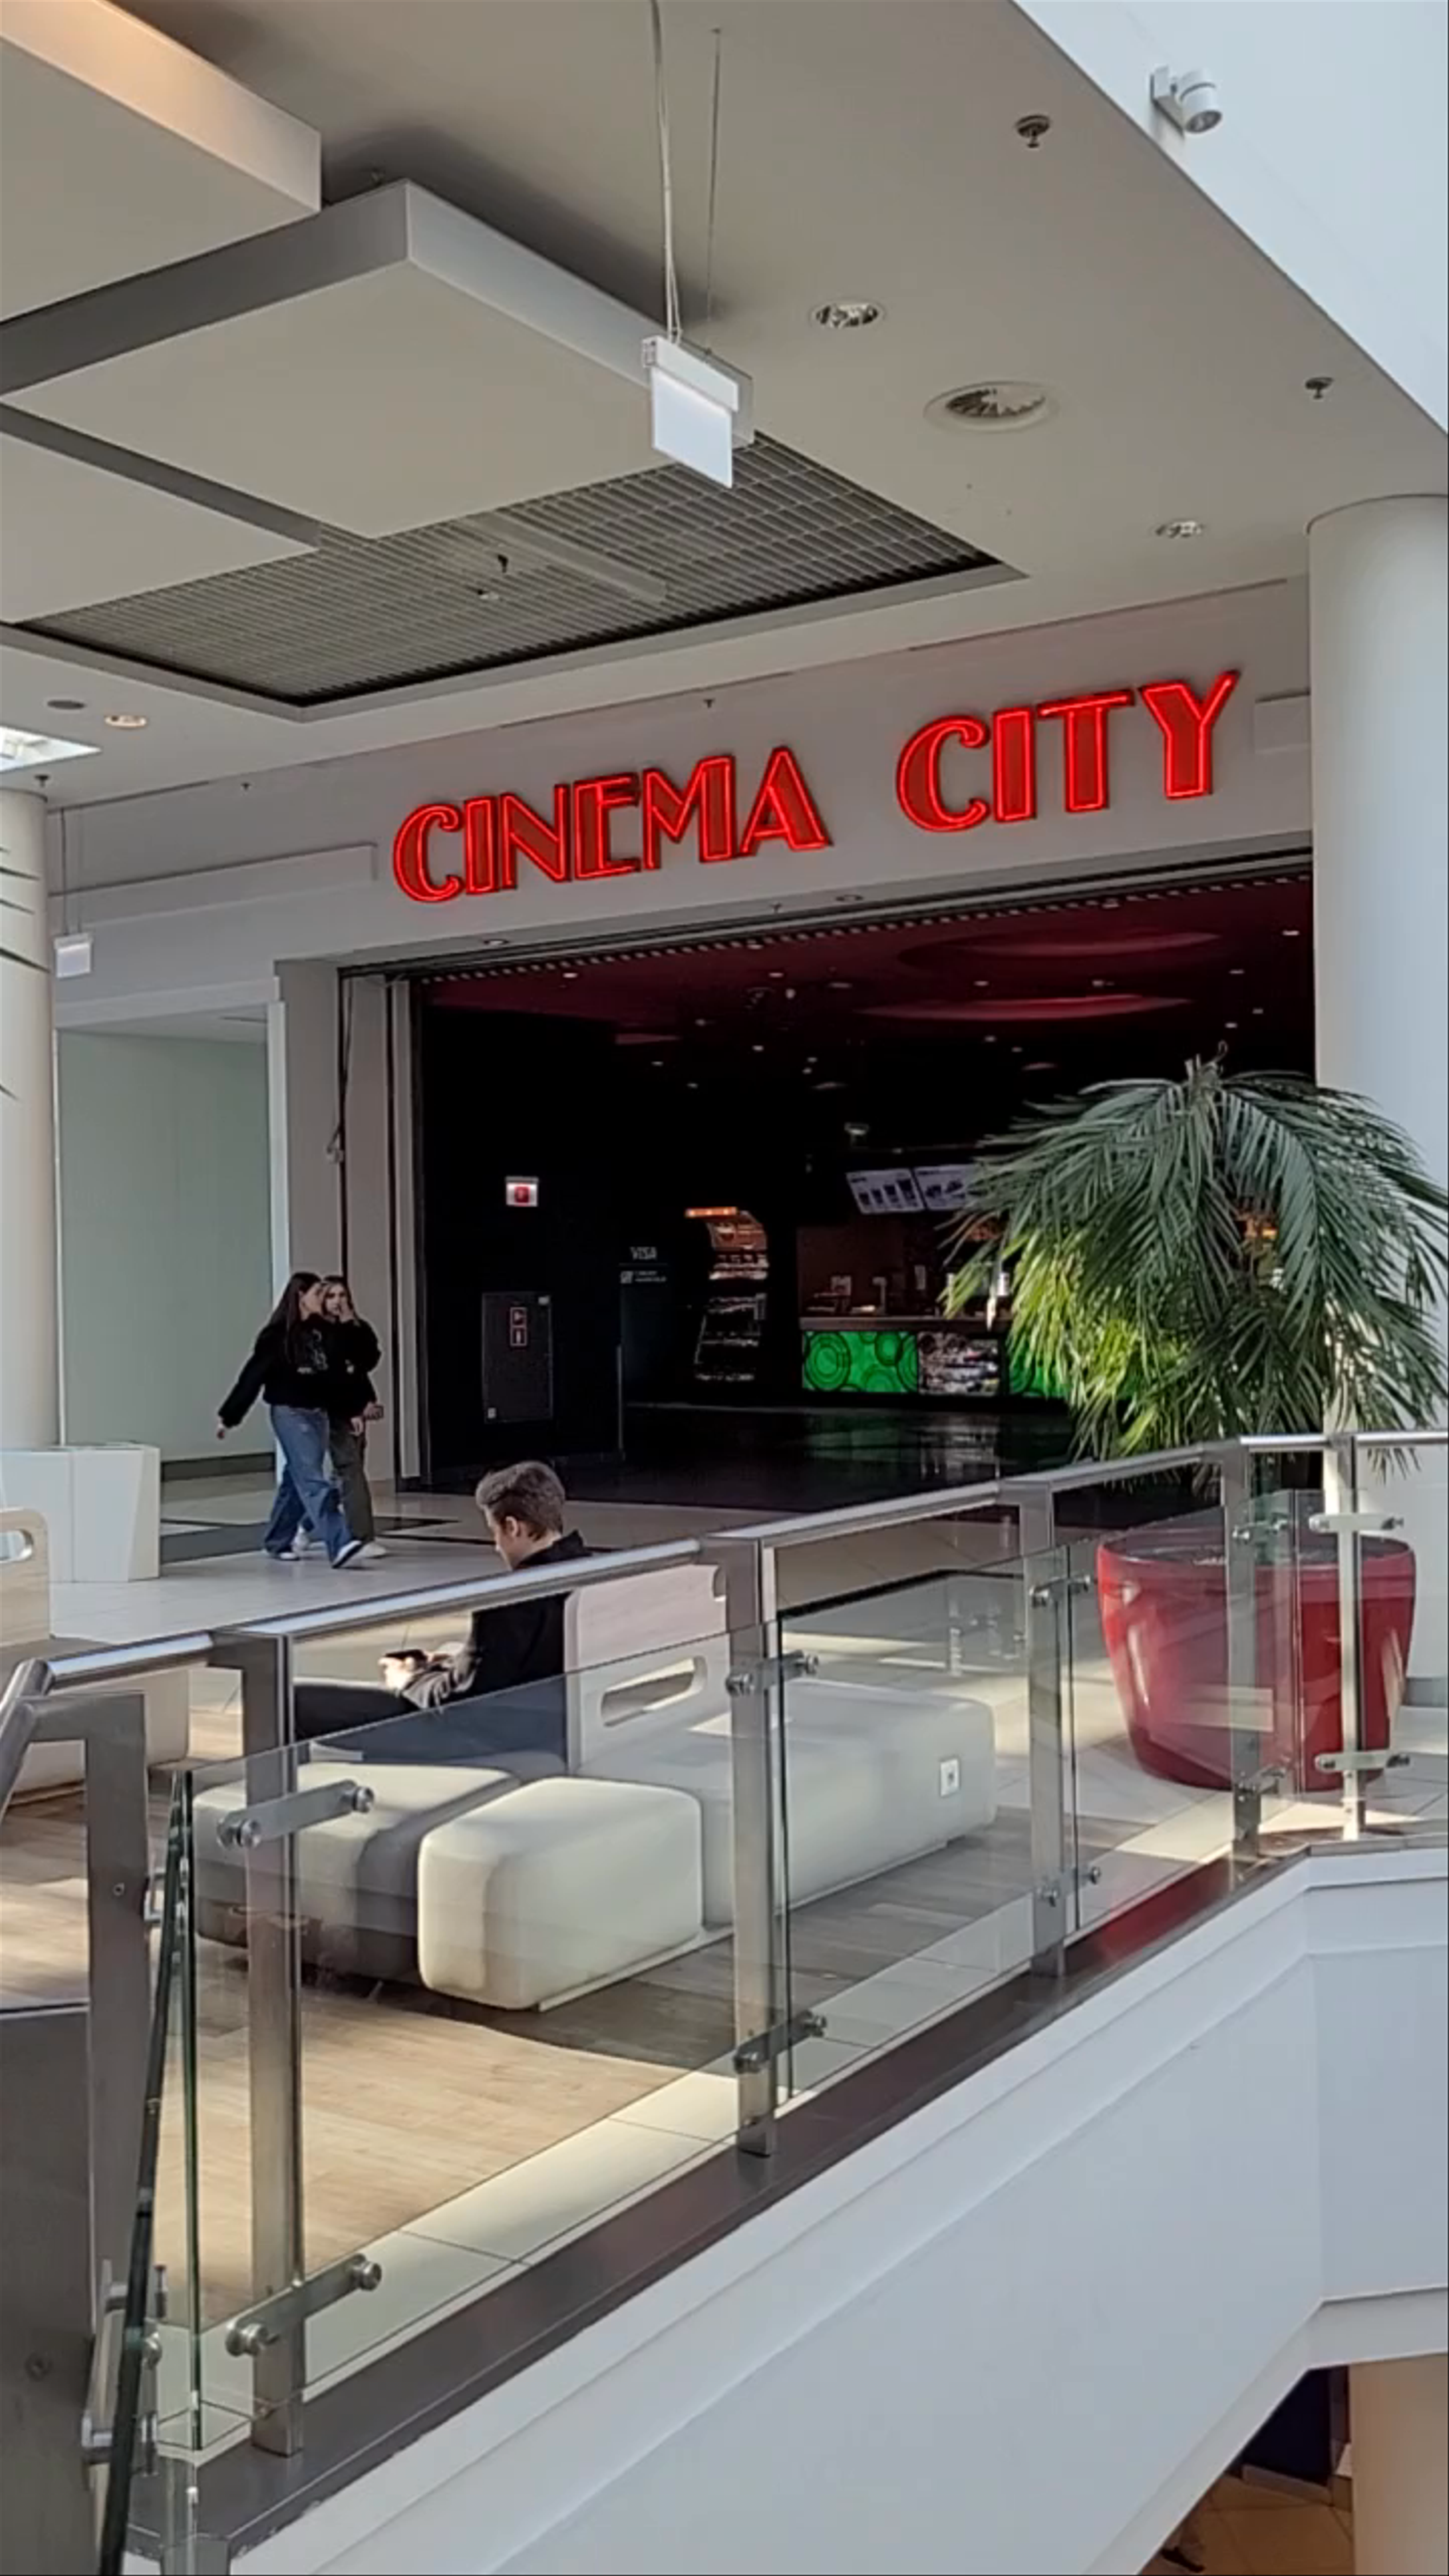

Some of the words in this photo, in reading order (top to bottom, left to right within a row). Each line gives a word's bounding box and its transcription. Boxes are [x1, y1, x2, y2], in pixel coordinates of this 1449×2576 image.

[392, 748, 831, 903] CINEMA
[895, 670, 1238, 834] CITY
[630, 1247, 657, 1260] VISA
